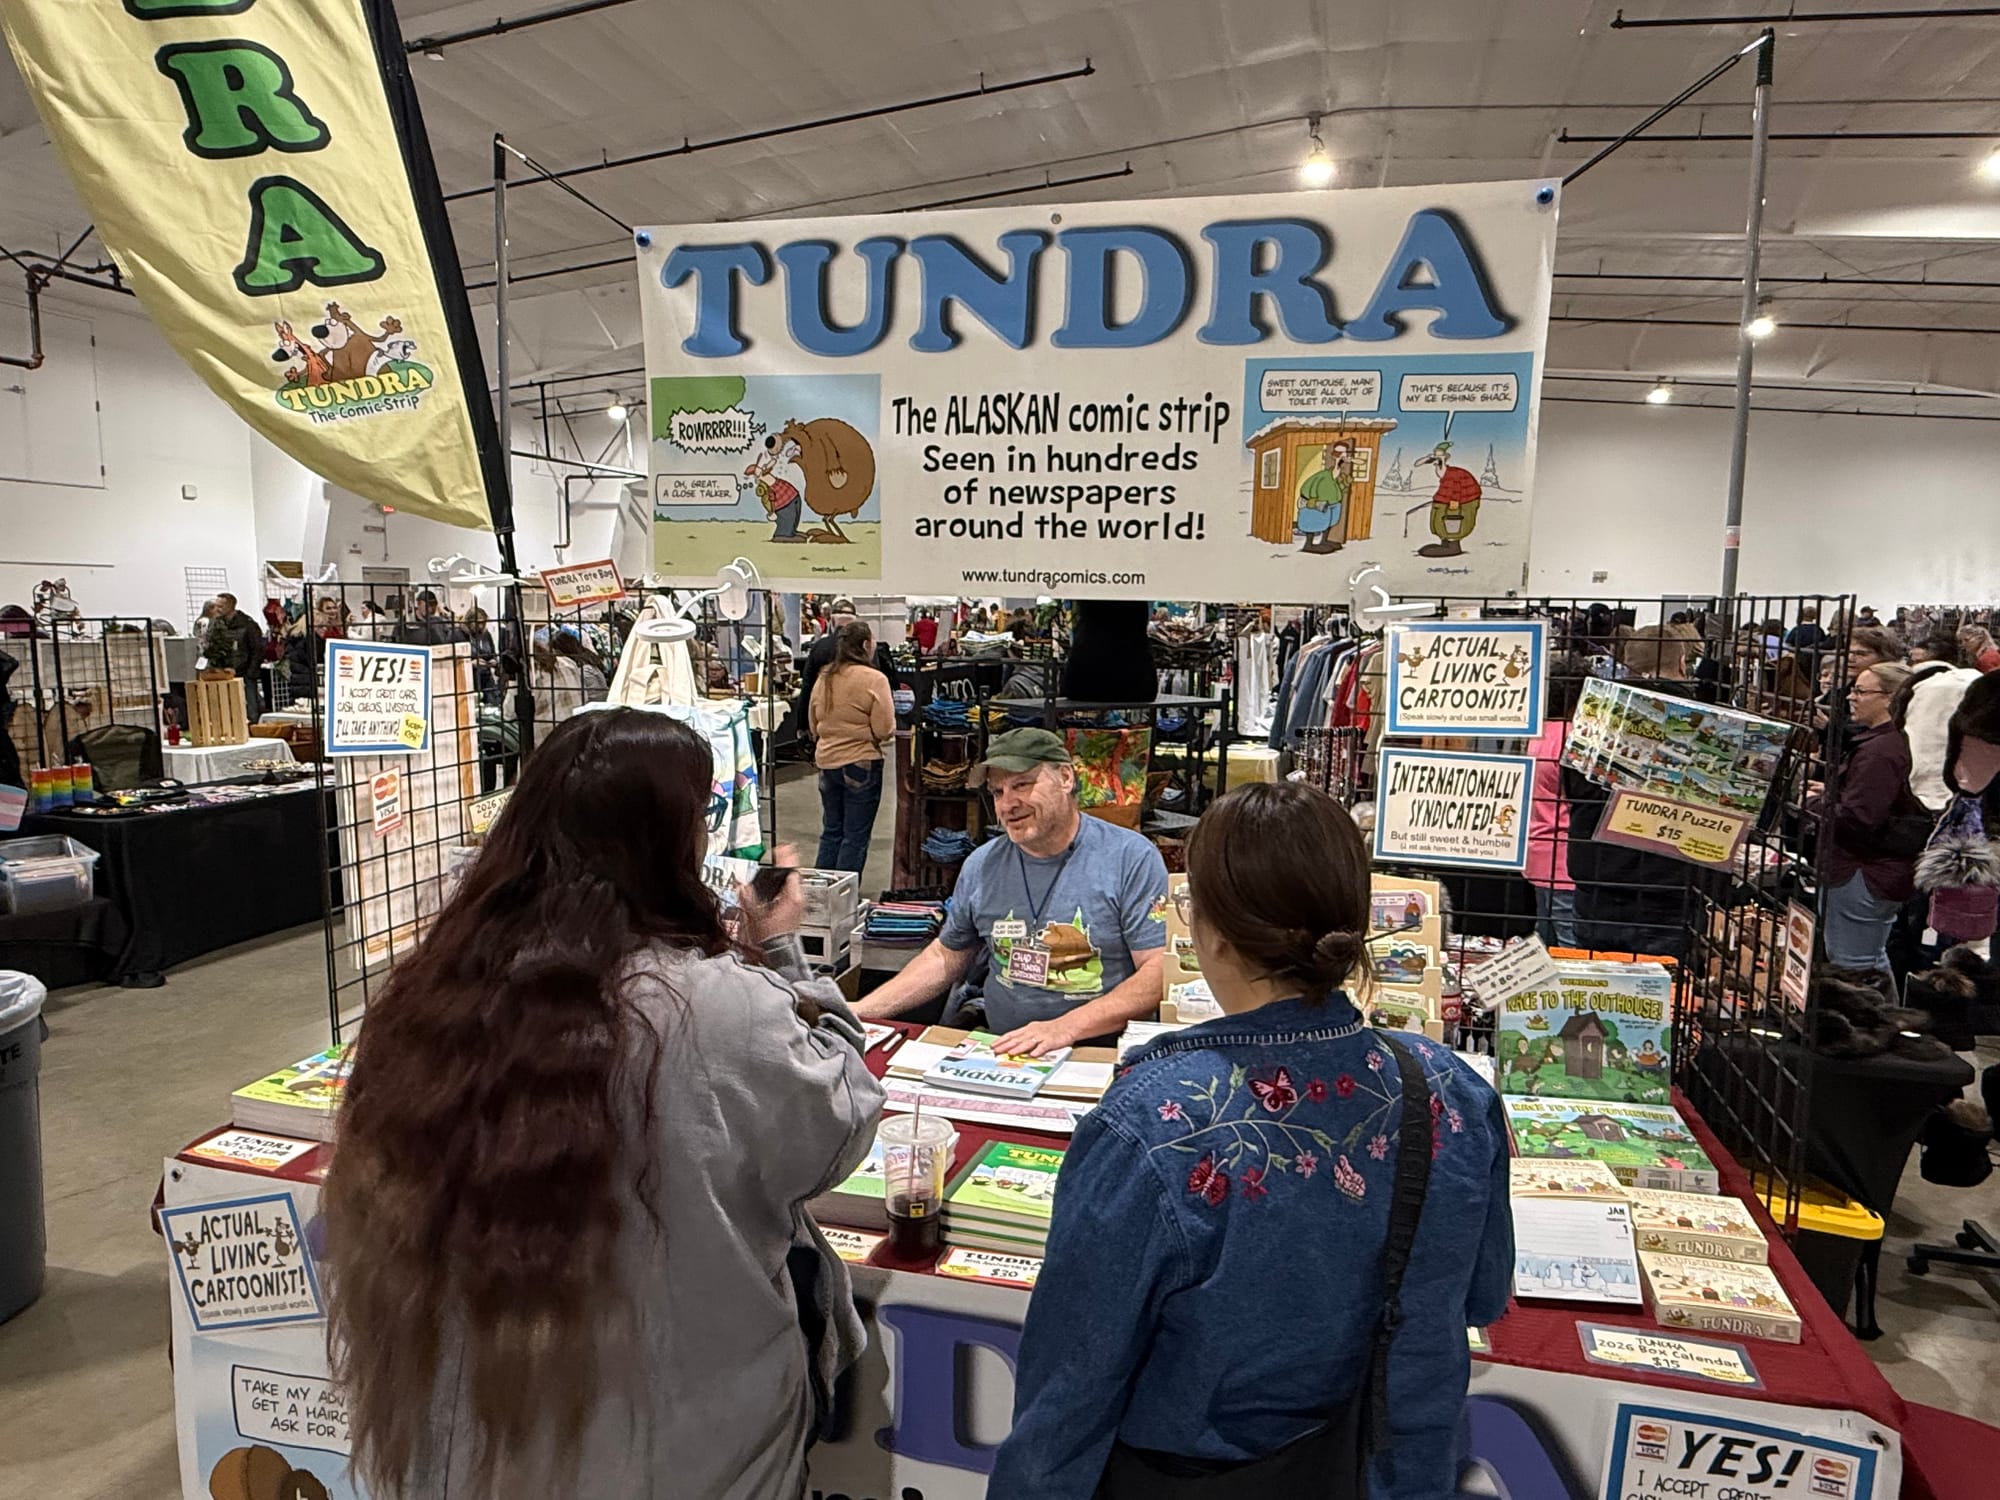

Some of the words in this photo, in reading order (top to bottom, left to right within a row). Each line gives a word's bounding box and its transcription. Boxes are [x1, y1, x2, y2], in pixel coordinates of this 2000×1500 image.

[660, 207, 1514, 356] TUNDRA
[281, 367, 432, 411] TUNDRA
[1266, 388, 1283, 398] BUT
[1287, 388, 1317, 397] YOU'RE
[1320, 387, 1335, 396] ALL
[1340, 387, 1357, 396] OUT
[1362, 387, 1374, 395] OF
[1267, 379, 1296, 388] SWEET
[1300, 378, 1347, 388] OUTHOUSE,
[1410, 383, 1443, 393] THAT'S
[1447, 383, 1487, 393] BECAUSE
[1491, 382, 1510, 392] IT'S
[308, 411, 337, 424] The
[339, 401, 382, 419] Comic
[383, 394, 420, 410] Strip
[1288, 397, 1317, 406] TOILET
[1406, 394, 1421, 403] MY
[1424, 394, 1438, 402] ICE
[1441, 393, 1477, 403] FISHING
[892, 397, 937, 436] The
[944, 391, 1060, 436] ALASKAN
[1068, 393, 1149, 434] comic
[1158, 391, 1231, 445] strip
[678, 419, 747, 442] ROWRRRR!!!
[923, 444, 995, 473] Seen
[1007, 445, 1036, 473] in
[1047, 442, 1199, 473] hundreds
[663, 489, 669, 498] A
[671, 489, 696, 498] CLOSE
[700, 489, 732, 499] TALKER.
[674, 480, 688, 490] OH,
[691, 479, 720, 489] GREAT.
[943, 478, 978, 505] of
[989, 483, 1177, 514] newspapers
[914, 511, 1024, 540] around
[1035, 512, 1088, 540] the
[1097, 511, 1206, 541] world!
[961, 568, 1146, 585] www.tundracomics.com
[1427, 634, 1499, 660] ACTUAL
[358, 655, 406, 684] YES!
[1429, 661, 1498, 686] LIVING
[340, 685, 345, 698] I
[1400, 686, 1528, 713] CARTOONIST!
[1426, 713, 1447, 723] slowly
[1449, 713, 1462, 722] and
[1464, 714, 1478, 722] use
[1479, 713, 1498, 722] small
[1388, 761, 1522, 801] INTERNATIONALLY
[1408, 798, 1498, 836] SYNDICATED!
[1625, 799, 1678, 822] TUNDRA
[1681, 810, 1733, 834] Puzzle
[1390, 830, 1408, 841] But
[1410, 832, 1427, 843] still
[1429, 834, 1459, 845] sweet
[1461, 835, 1470, 845] &
[1472, 837, 1511, 849] humble
[1656, 825, 1683, 841] $15
[1539, 991, 1560, 1010] TO
[1561, 989, 1588, 1011] THE
[1589, 992, 1665, 1021] OUTHOUSE!
[939, 1065, 1033, 1085] TUNDRA
[234, 1135, 294, 1151] TUNDRA
[1607, 1206, 1626, 1216] JAN
[201, 1210, 264, 1245] ACTUAL
[822, 1230, 862, 1243] DRA
[1622, 1224, 1630, 1235] 1
[211, 1241, 270, 1276] LIVING
[1675, 1240, 1735, 1259] TUNDRA
[191, 1265, 306, 1308] CARTOONIST!
[1701, 1316, 1765, 1337] TUNDRA
[1598, 1338, 1635, 1352] 2026
[1638, 1344, 1669, 1358] Box
[1672, 1350, 1740, 1369] Calendar
[1635, 1336, 1687, 1353] TUNDRA
[1652, 1356, 1681, 1369] $15
[241, 1378, 279, 1396] TAKE
[286, 1386, 311, 1401] MY
[251, 1397, 280, 1413] GET
[287, 1403, 299, 1417] A
[306, 1406, 350, 1425] HAIRC
[270, 1417, 300, 1432] ASK
[306, 1422, 337, 1438] FOR
[1676, 1429, 1805, 1489] YES!
[1637, 1469, 1645, 1486] I
[1653, 1474, 1711, 1499] ACCEPT
